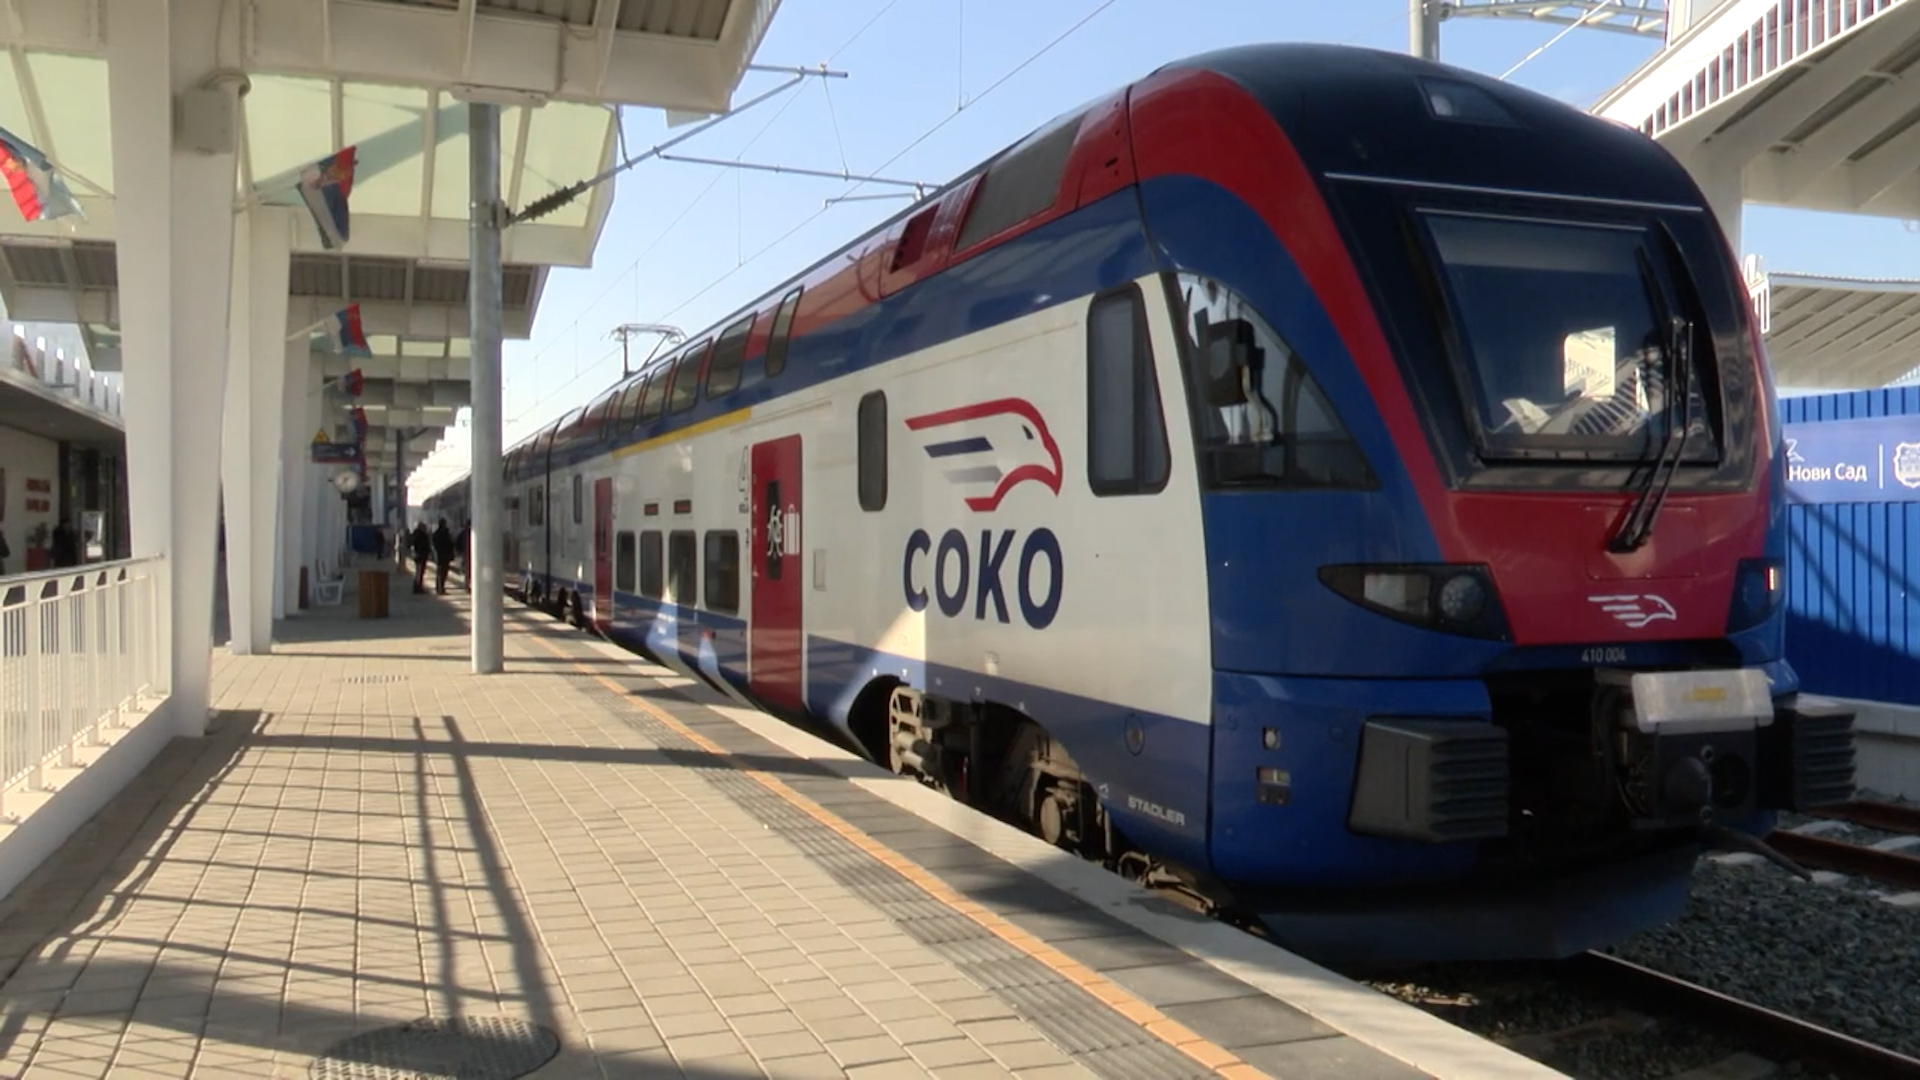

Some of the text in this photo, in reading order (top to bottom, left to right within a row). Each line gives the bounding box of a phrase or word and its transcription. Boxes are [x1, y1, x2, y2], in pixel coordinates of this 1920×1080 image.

[1788, 462, 1868, 482] Нови Сад
[903, 527, 1064, 630] СОКО
[1581, 647, 1604, 662] 410
[1127, 795, 1185, 826] STADLER
